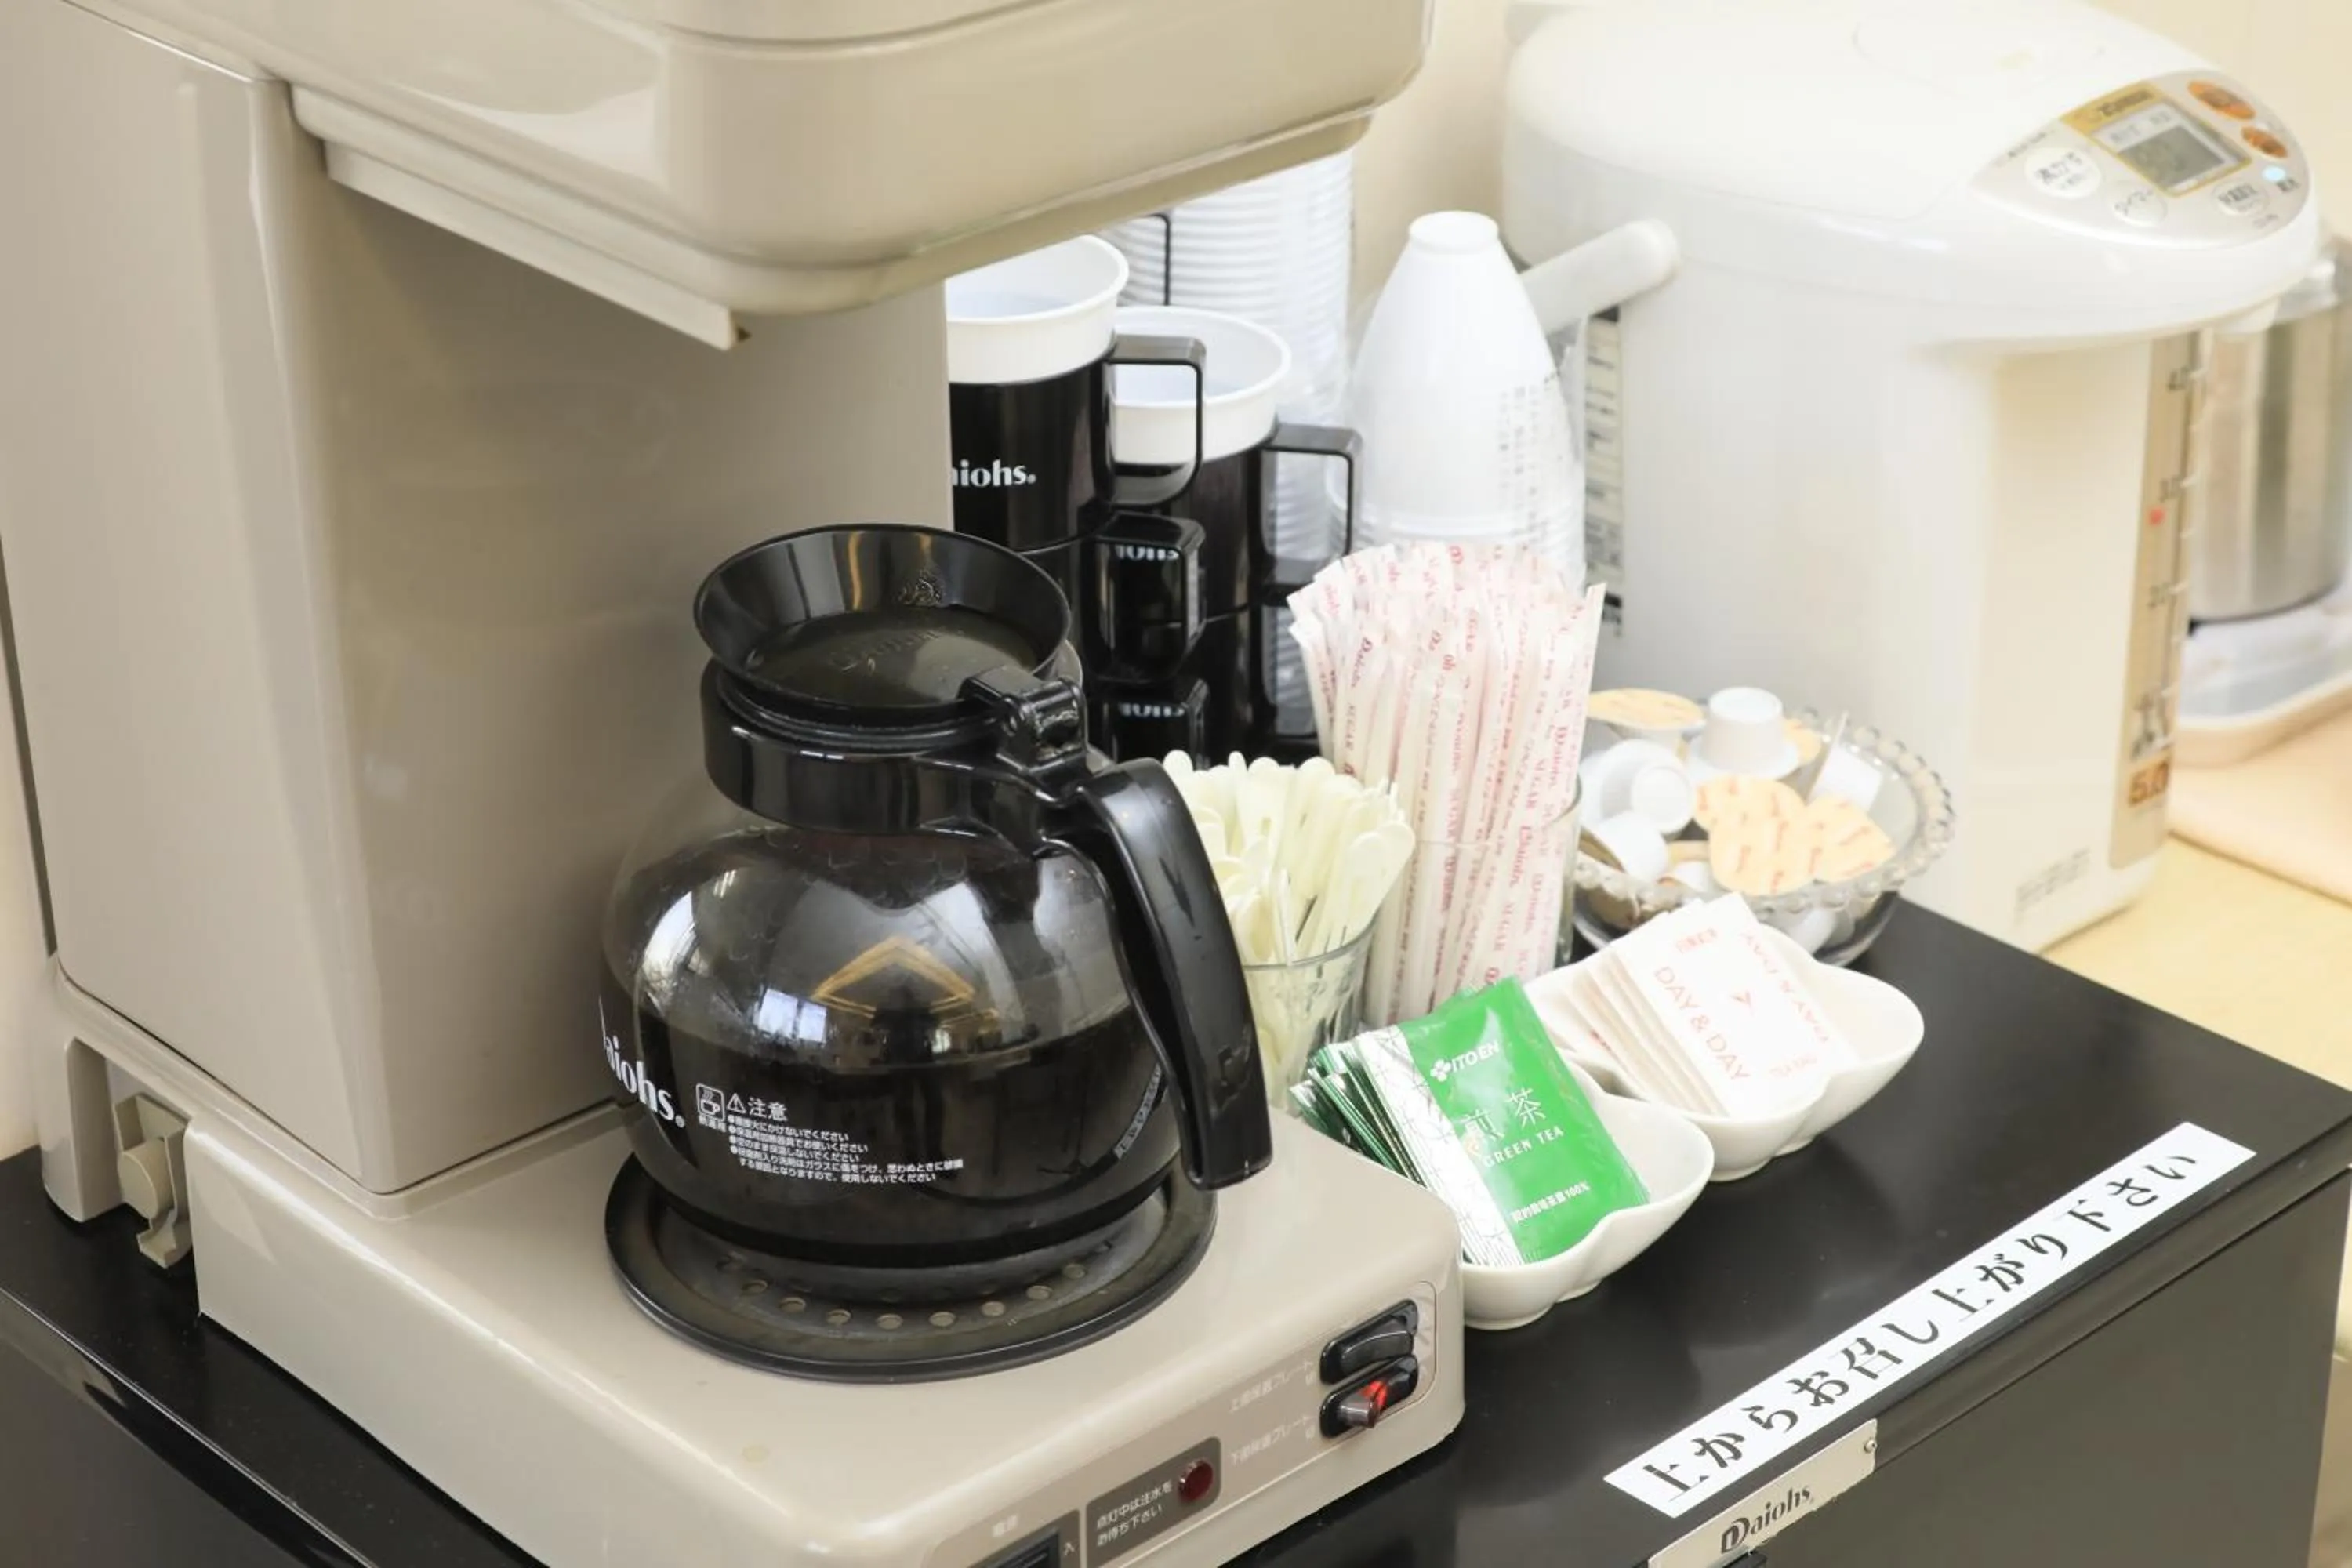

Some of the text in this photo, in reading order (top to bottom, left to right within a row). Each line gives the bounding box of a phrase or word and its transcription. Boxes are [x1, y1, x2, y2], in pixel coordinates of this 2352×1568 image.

[1654, 966, 1700, 1010] DAY
[1690, 1014, 1711, 1033] &
[1705, 1033, 1751, 1080] DAY
[747, 1097, 789, 1121] 注意
[1483, 1125, 1564, 1167] GREEN TEA
[1642, 1155, 2198, 1502] 上からお召し上がり下さい
